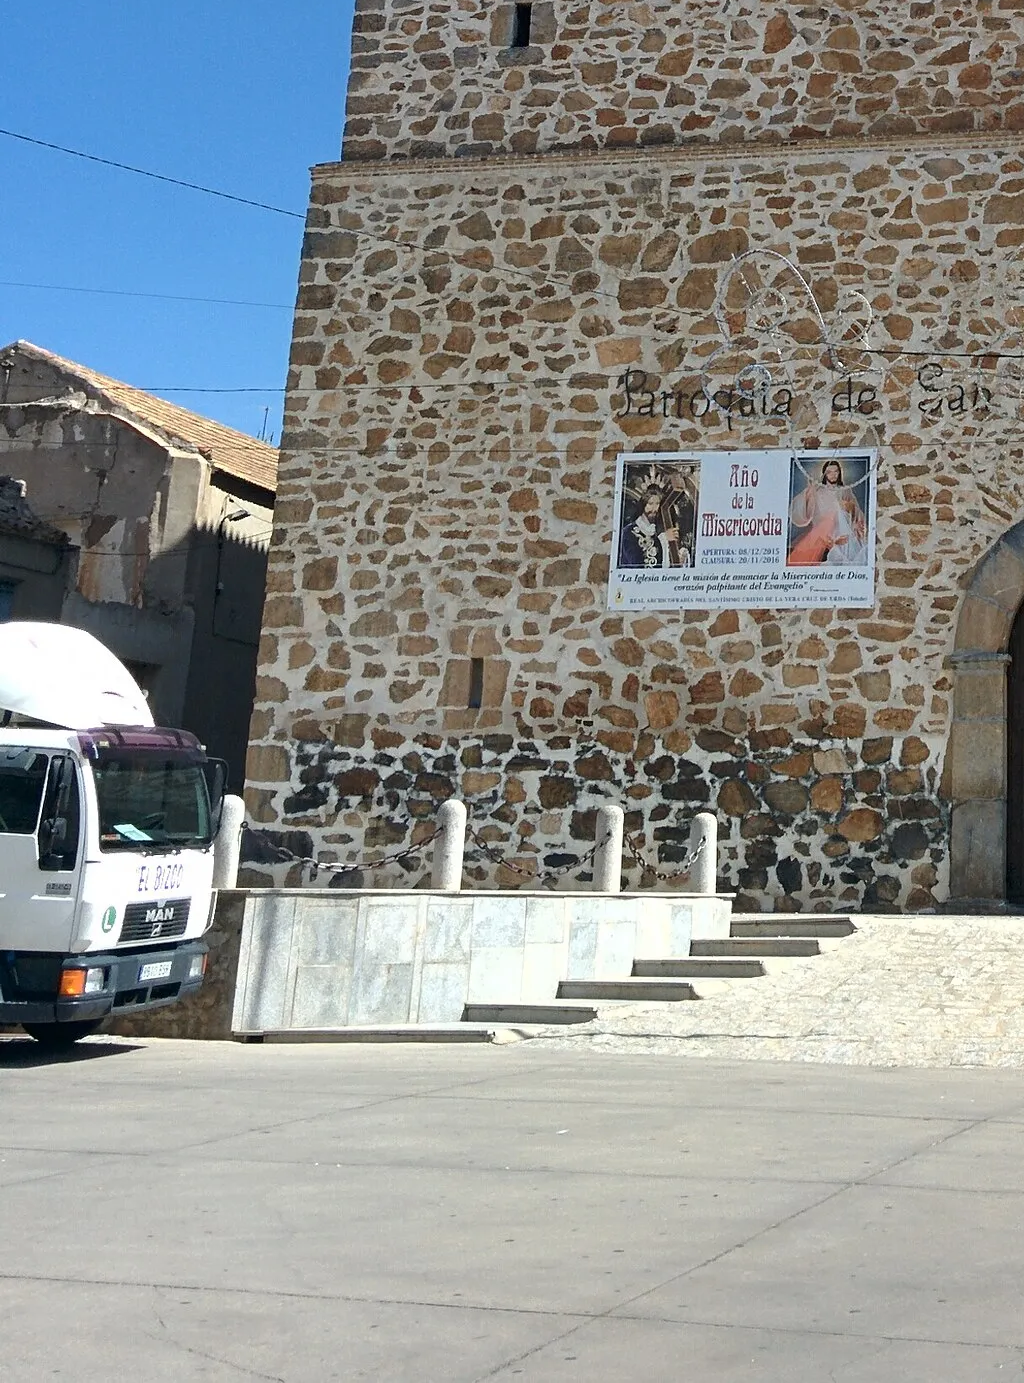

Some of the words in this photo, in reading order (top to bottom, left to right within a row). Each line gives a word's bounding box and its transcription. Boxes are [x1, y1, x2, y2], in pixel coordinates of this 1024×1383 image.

[616, 366, 793, 431] Parroquia
[831, 368, 877, 414] de
[918, 363, 991, 413] San
[729, 464, 759, 487] Año
[731, 493, 743, 509] de
[745, 493, 754, 509] la
[701, 512, 783, 536] Misericordia
[738, 556, 780, 564] 20/11/2016
[634, 574, 660, 584] Iglesia
[661, 574, 681, 582] tiene
[682, 573, 690, 581] la
[692, 573, 718, 581] misión
[720, 572, 730, 581] de
[732, 573, 769, 581] anunciar
[770, 572, 779, 580] la
[781, 571, 833, 580] Misericordia
[835, 571, 845, 580] de
[847, 570, 868, 581] Dios,
[673, 583, 704, 591] corazón
[706, 582, 747, 593] palpitante
[749, 582, 761, 590] del
[145, 907, 174, 922] MAN
